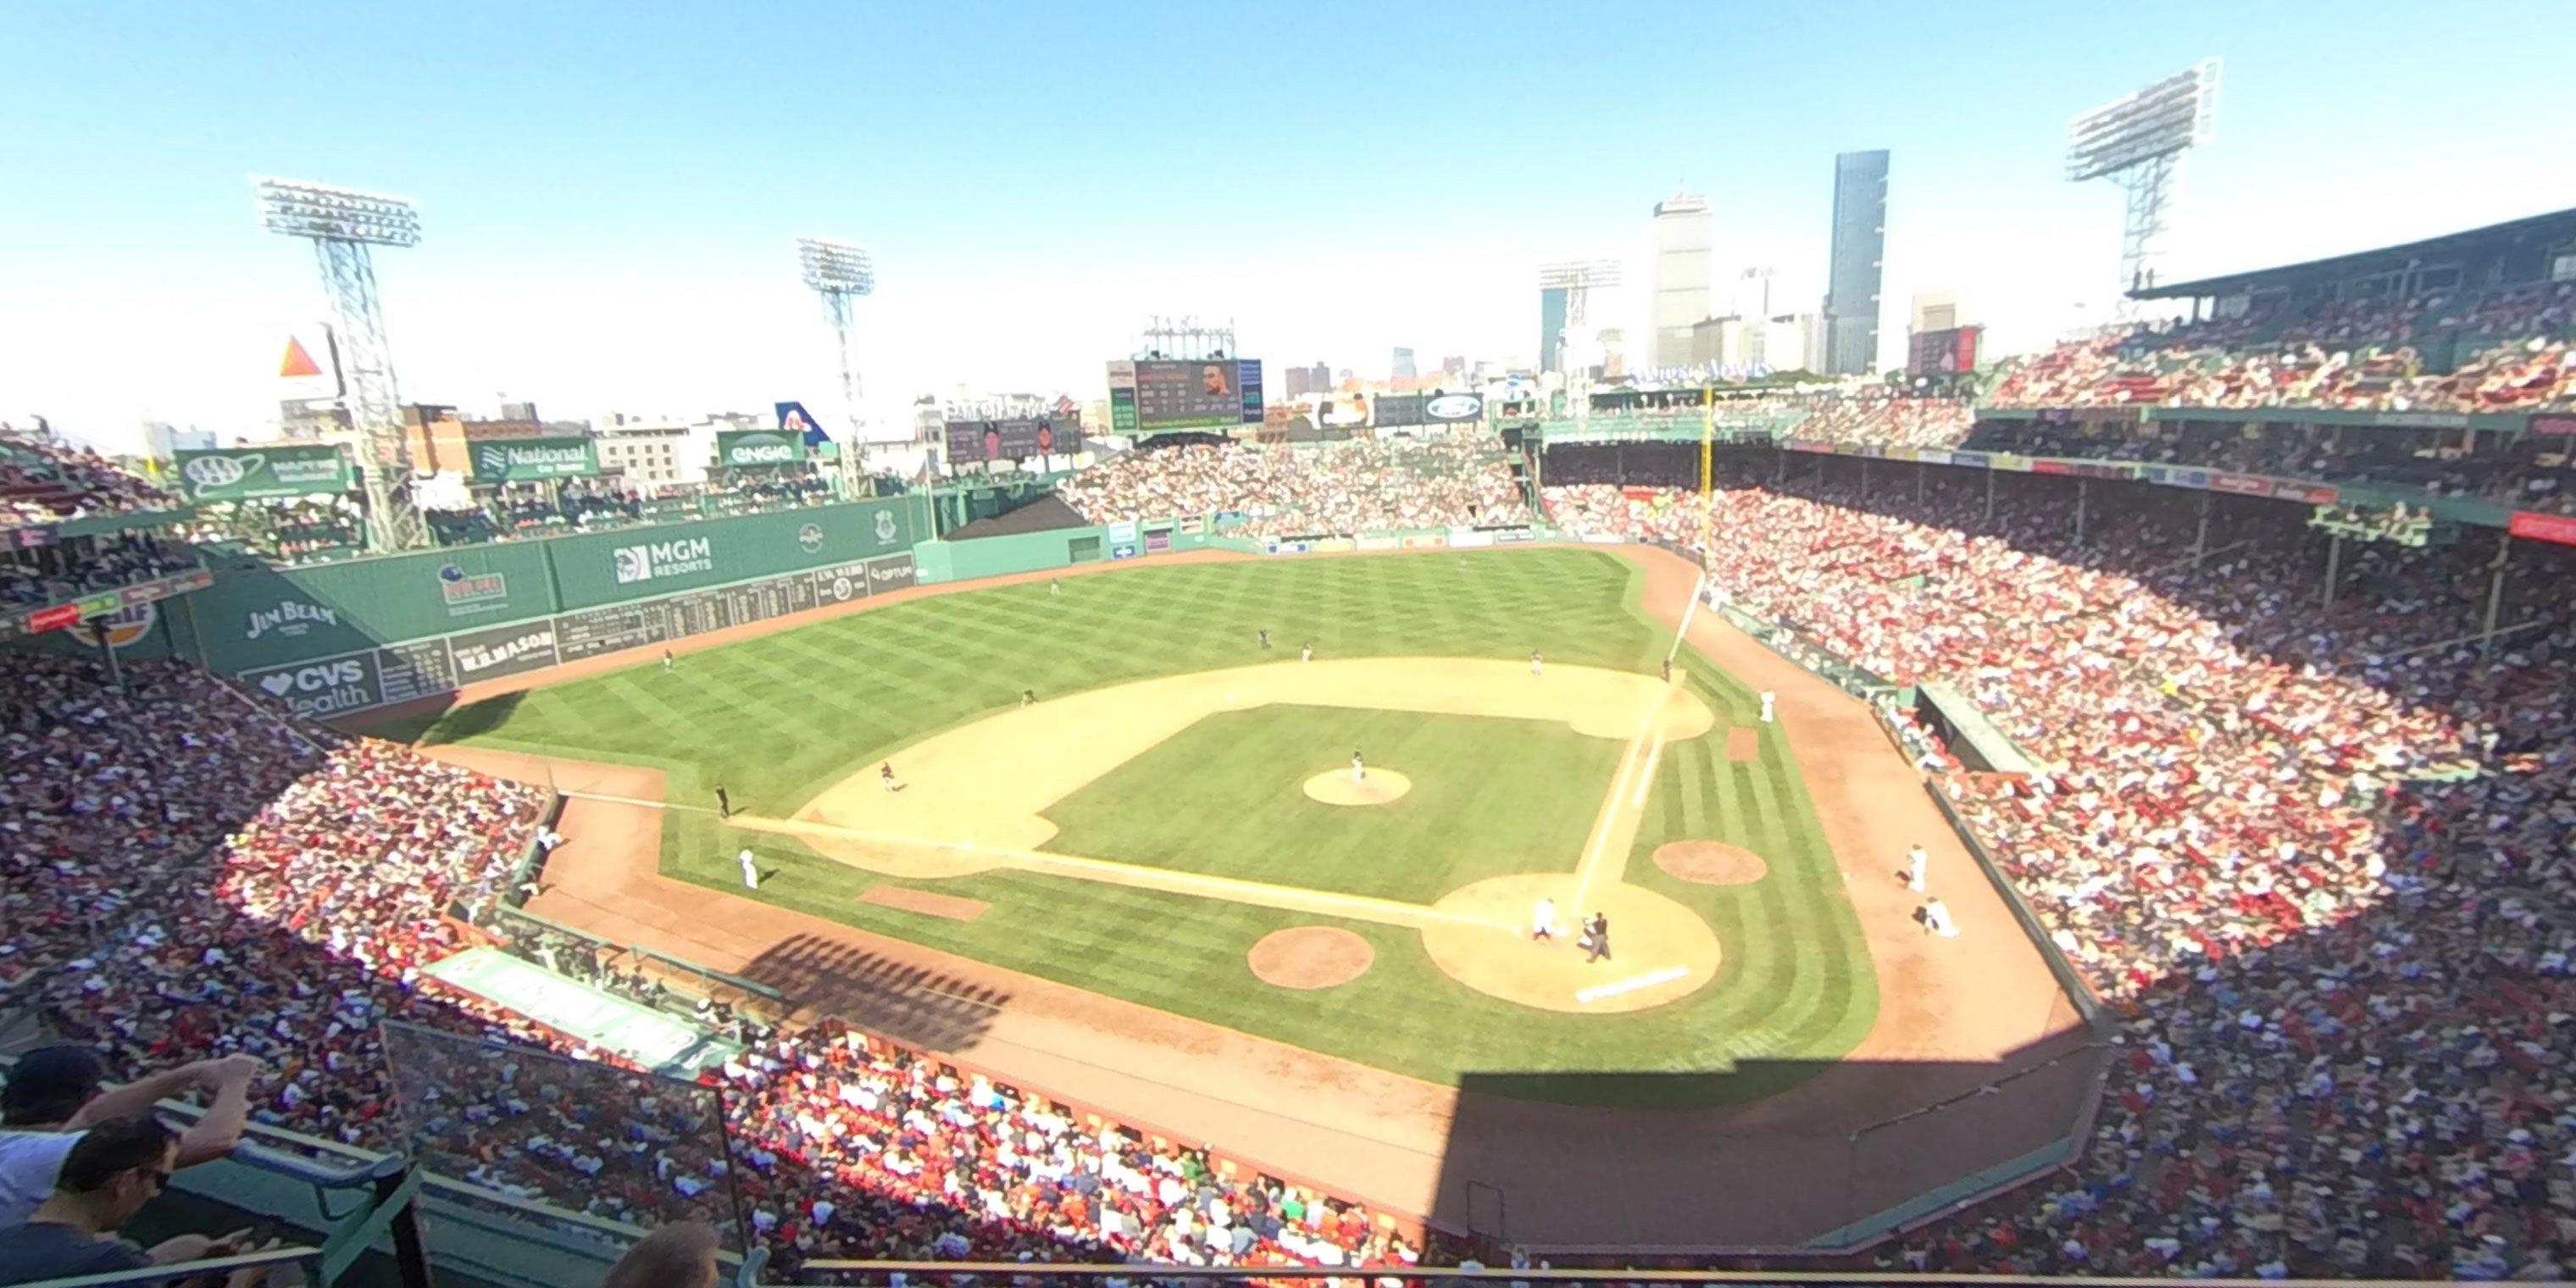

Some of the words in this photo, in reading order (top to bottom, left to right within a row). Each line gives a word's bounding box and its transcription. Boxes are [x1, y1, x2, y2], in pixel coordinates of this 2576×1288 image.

[651, 536, 711, 564] MGM
[653, 558, 713, 577] RESORTS
[247, 608, 282, 639] JIM
[280, 601, 337, 626] BEAM
[297, 660, 364, 692] CVS
